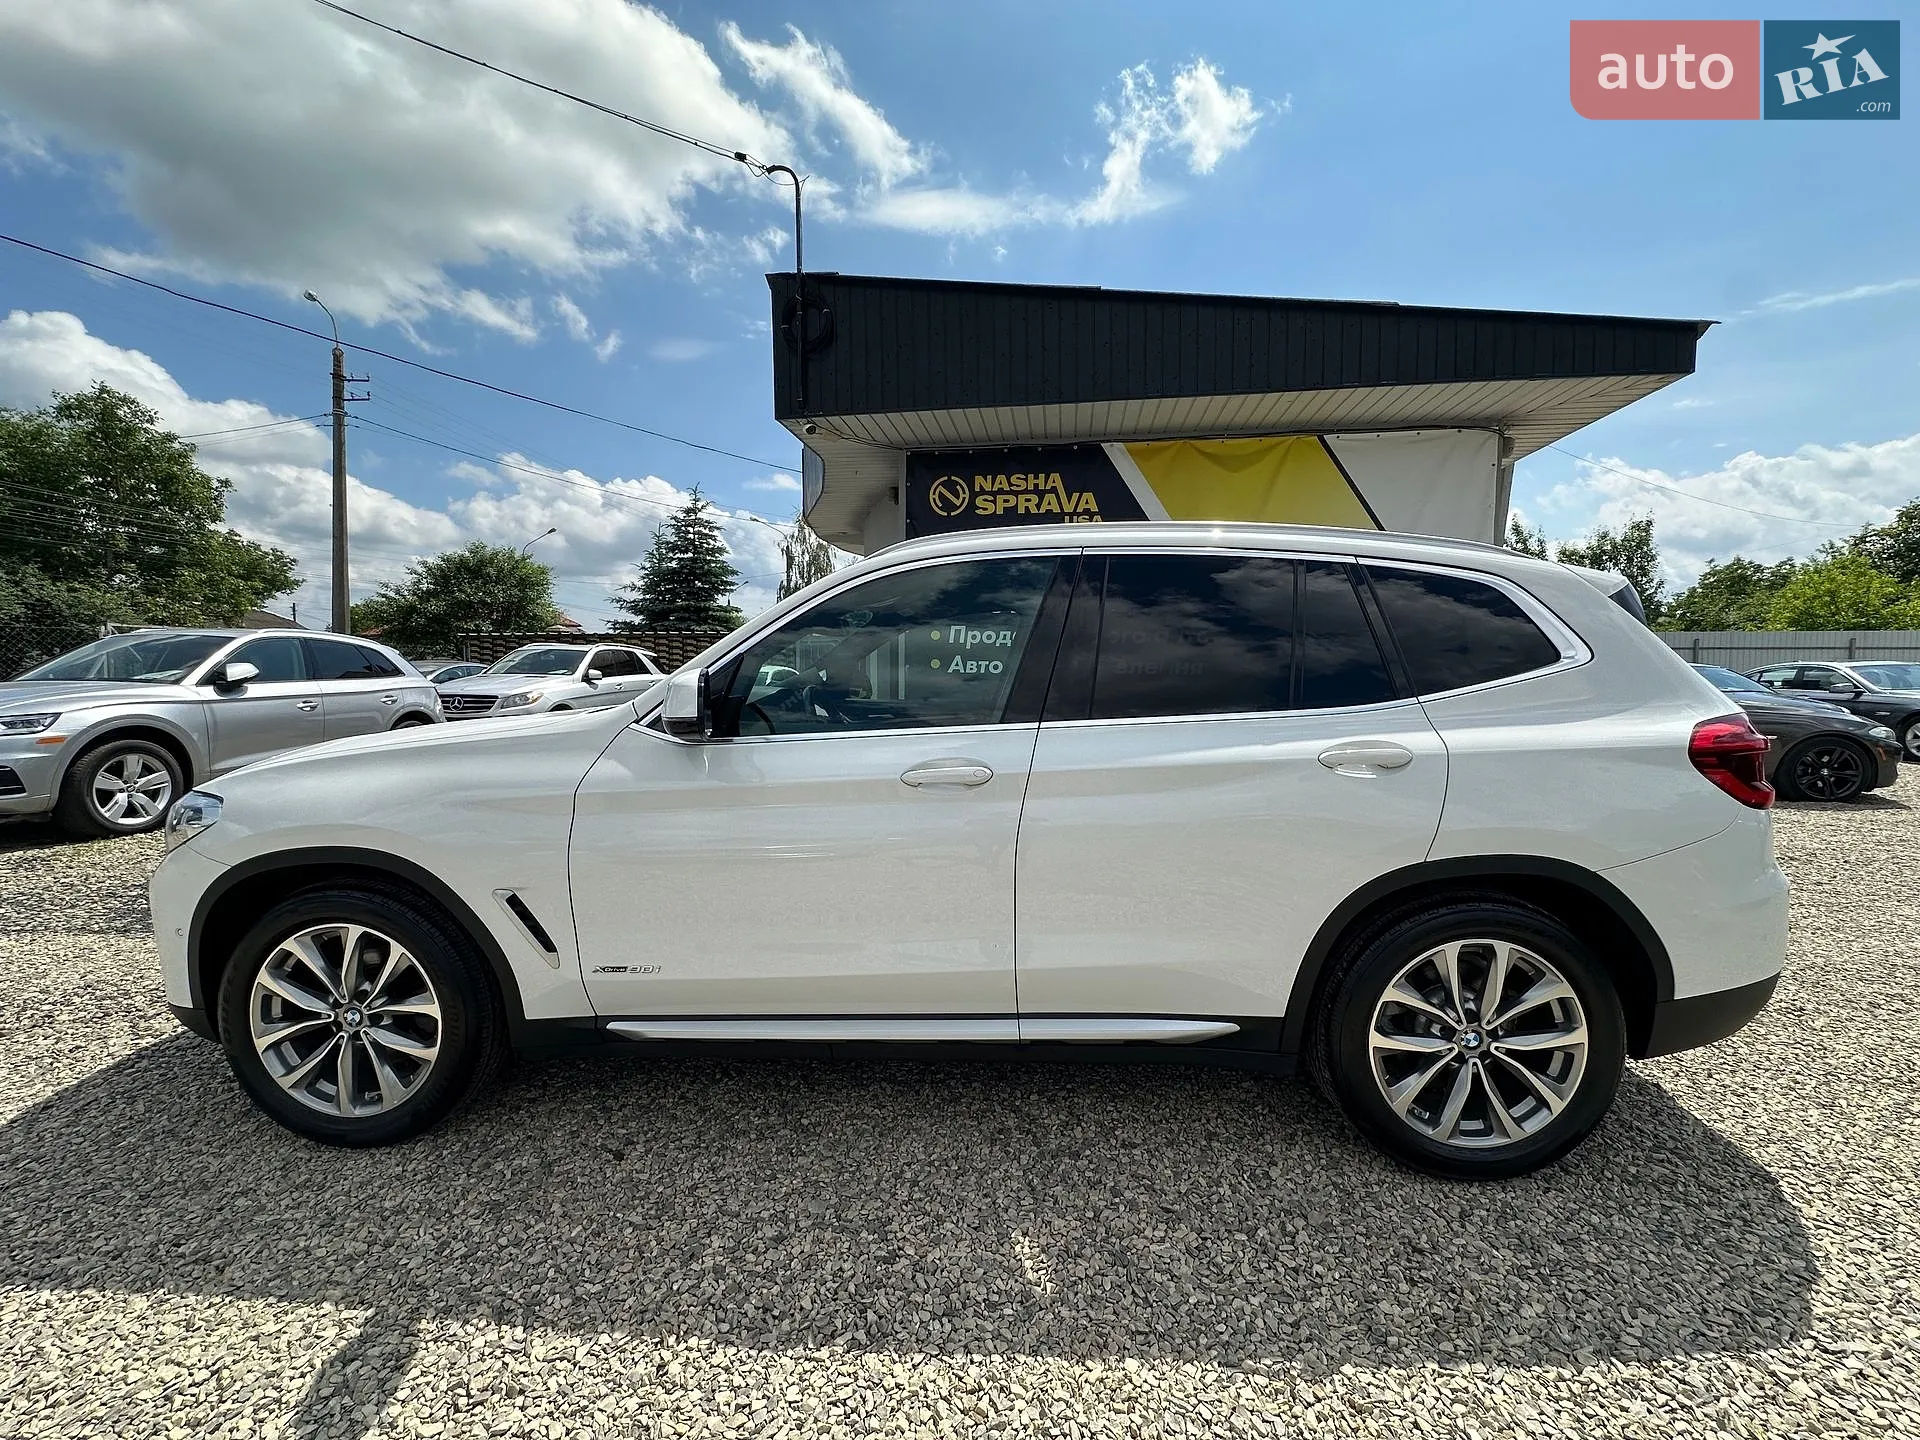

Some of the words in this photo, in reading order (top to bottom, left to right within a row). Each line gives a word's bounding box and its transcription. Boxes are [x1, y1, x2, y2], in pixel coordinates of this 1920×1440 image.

[974, 473, 1061, 492] NASHA
[974, 492, 1099, 515] SPRAVA
[948, 625, 1017, 649] Прод
[947, 655, 1004, 674] Авто
